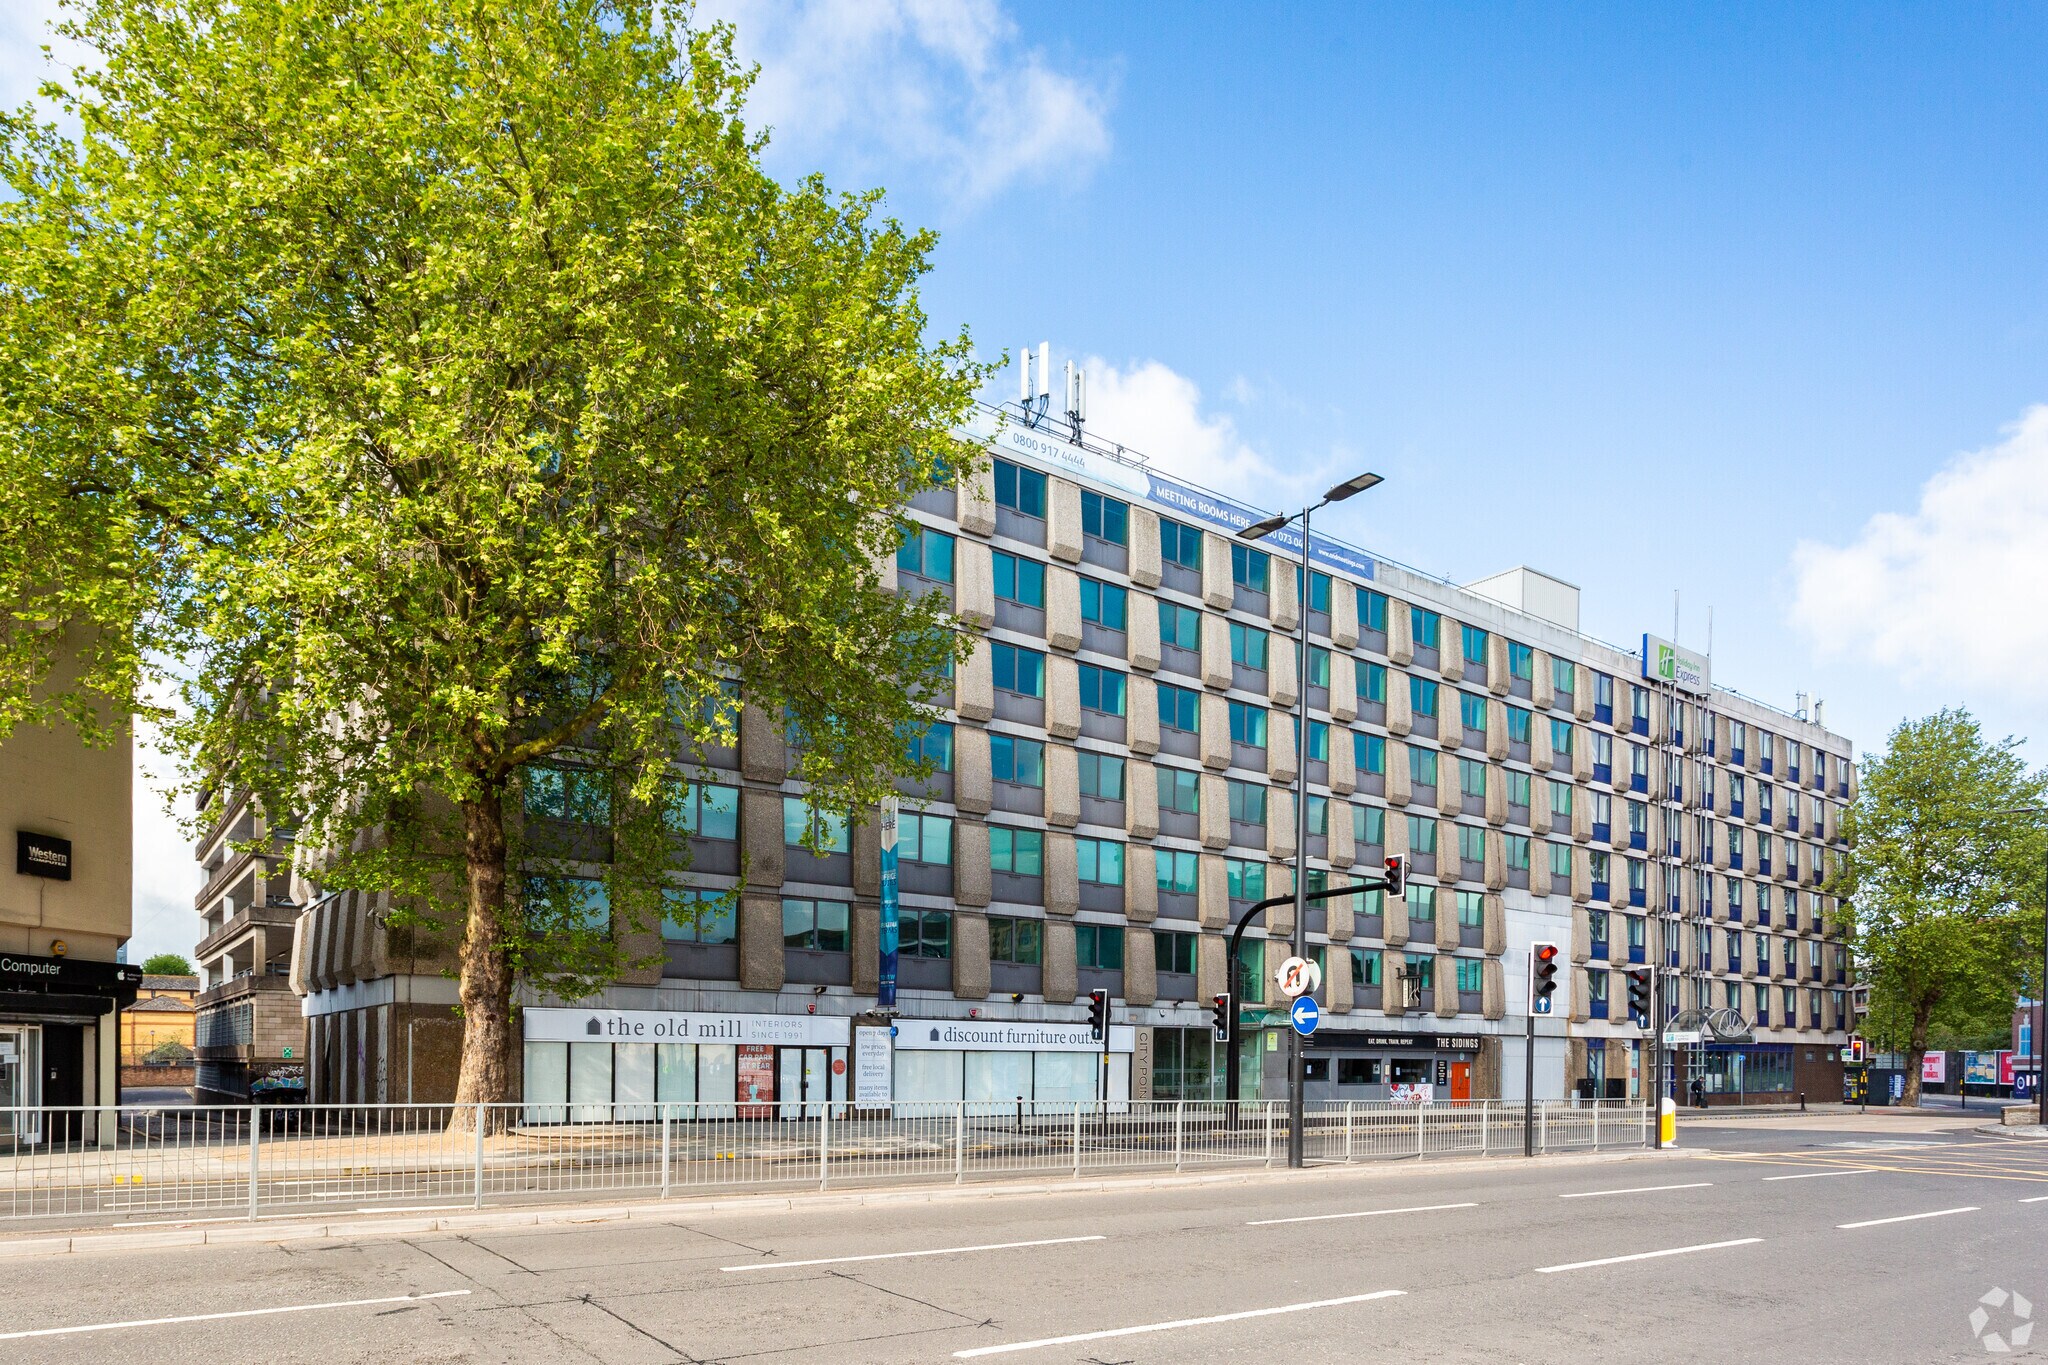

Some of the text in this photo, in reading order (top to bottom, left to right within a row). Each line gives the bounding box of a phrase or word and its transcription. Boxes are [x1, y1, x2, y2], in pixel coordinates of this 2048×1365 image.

[1013, 432, 1085, 468] 0800 917 4444
[1156, 485, 1197, 510] MEETING
[1198, 502, 1229, 521] ROOMS
[1229, 513, 1251, 529] HERE
[1278, 531, 1292, 545] 073
[1676, 665, 1700, 686] Express
[28, 845, 67, 863] Western
[28, 856, 67, 867] COMPUTER
[1, 957, 61, 976] Computer
[607, 1017, 743, 1038] the old mill
[751, 1020, 803, 1028] INTERIORS
[751, 1031, 803, 1039] SINCE 1991
[877, 1029, 888, 1038] days
[944, 1026, 1003, 1043] discount
[1006, 1028, 1066, 1044] furniture
[1139, 1032, 1148, 1064] CITY
[1436, 1038, 1479, 1048] THE SIDINGS
[746, 1045, 764, 1053] FREE
[739, 1053, 773, 1061] CAR PARK
[741, 1062, 770, 1070] AT REAR
[862, 1070, 885, 1078] delivery
